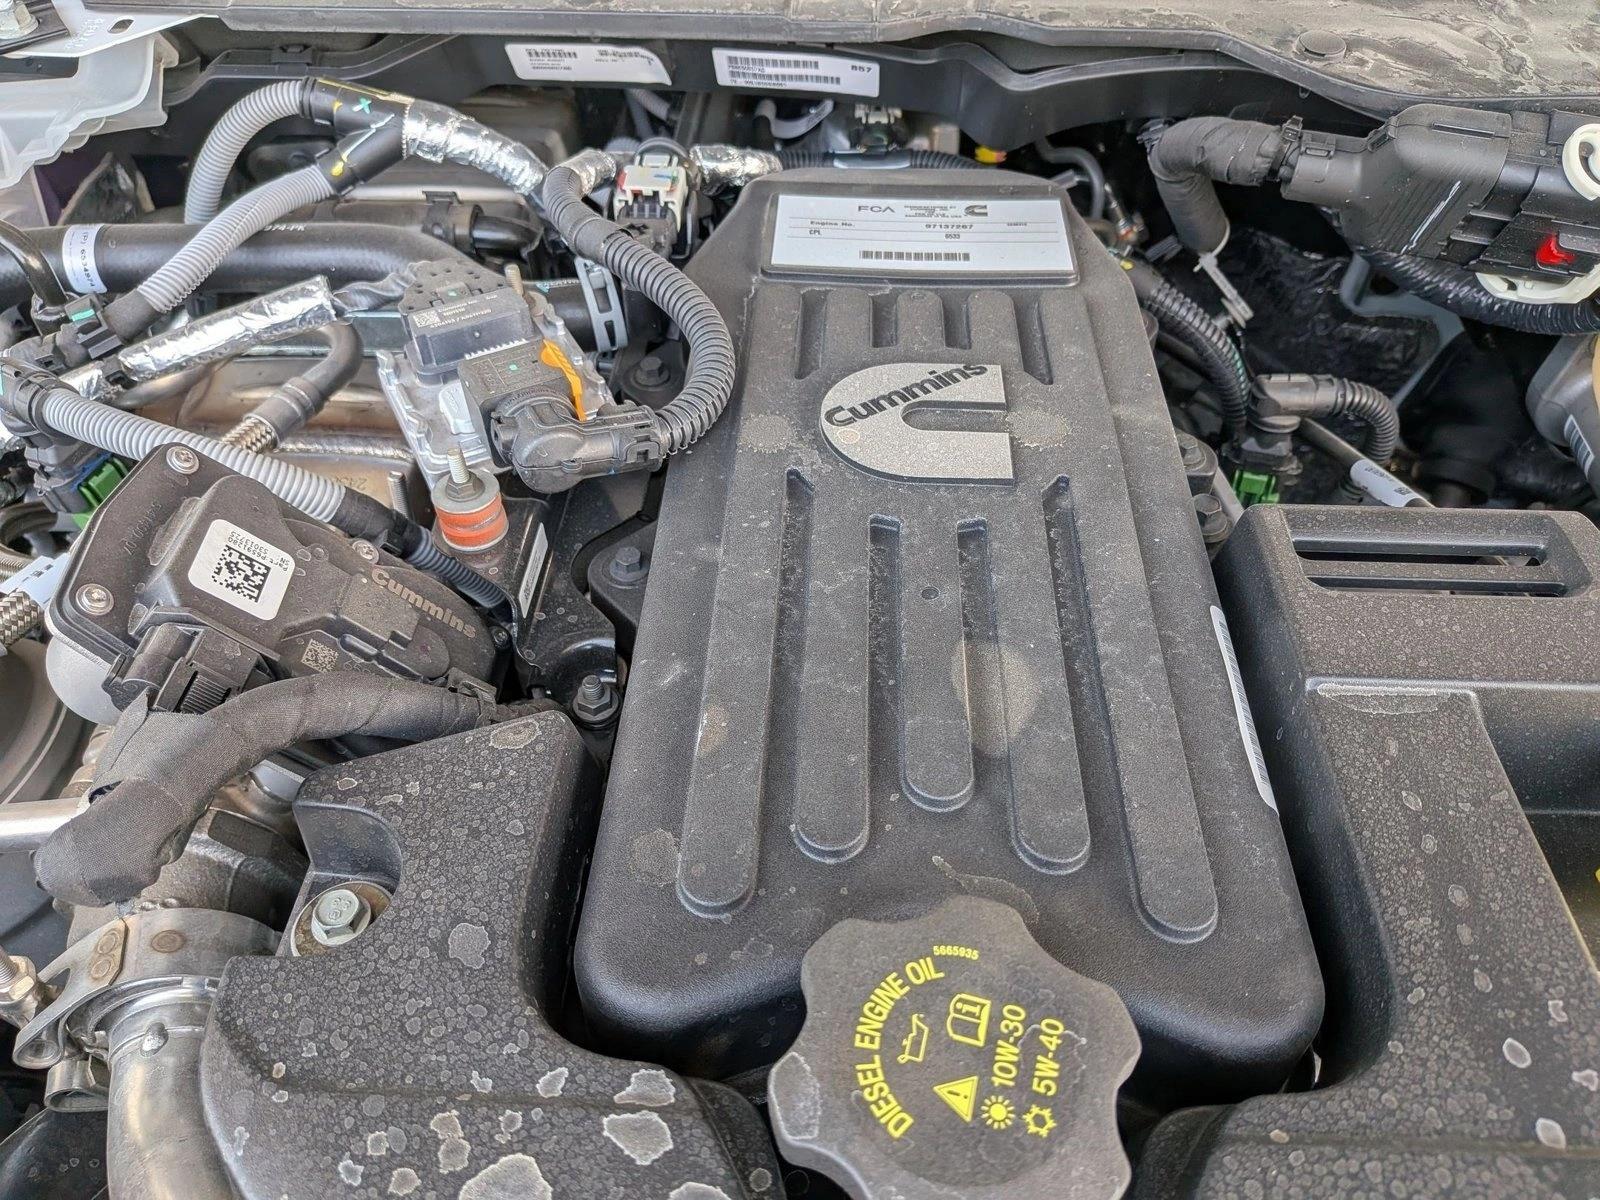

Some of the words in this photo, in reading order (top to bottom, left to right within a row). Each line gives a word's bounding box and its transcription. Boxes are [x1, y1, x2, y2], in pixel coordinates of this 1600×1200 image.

[857, 205, 896, 213] FCA
[824, 363, 989, 428] Cummins
[371, 567, 477, 639] Cummins
[904, 956, 945, 986] OIL
[932, 945, 980, 960] 5665935
[854, 971, 911, 1050] ENGINE
[991, 1004, 1027, 1087] 10W-30
[1032, 1018, 1065, 1097] 5W-40
[855, 1054, 915, 1139] DIESEL
